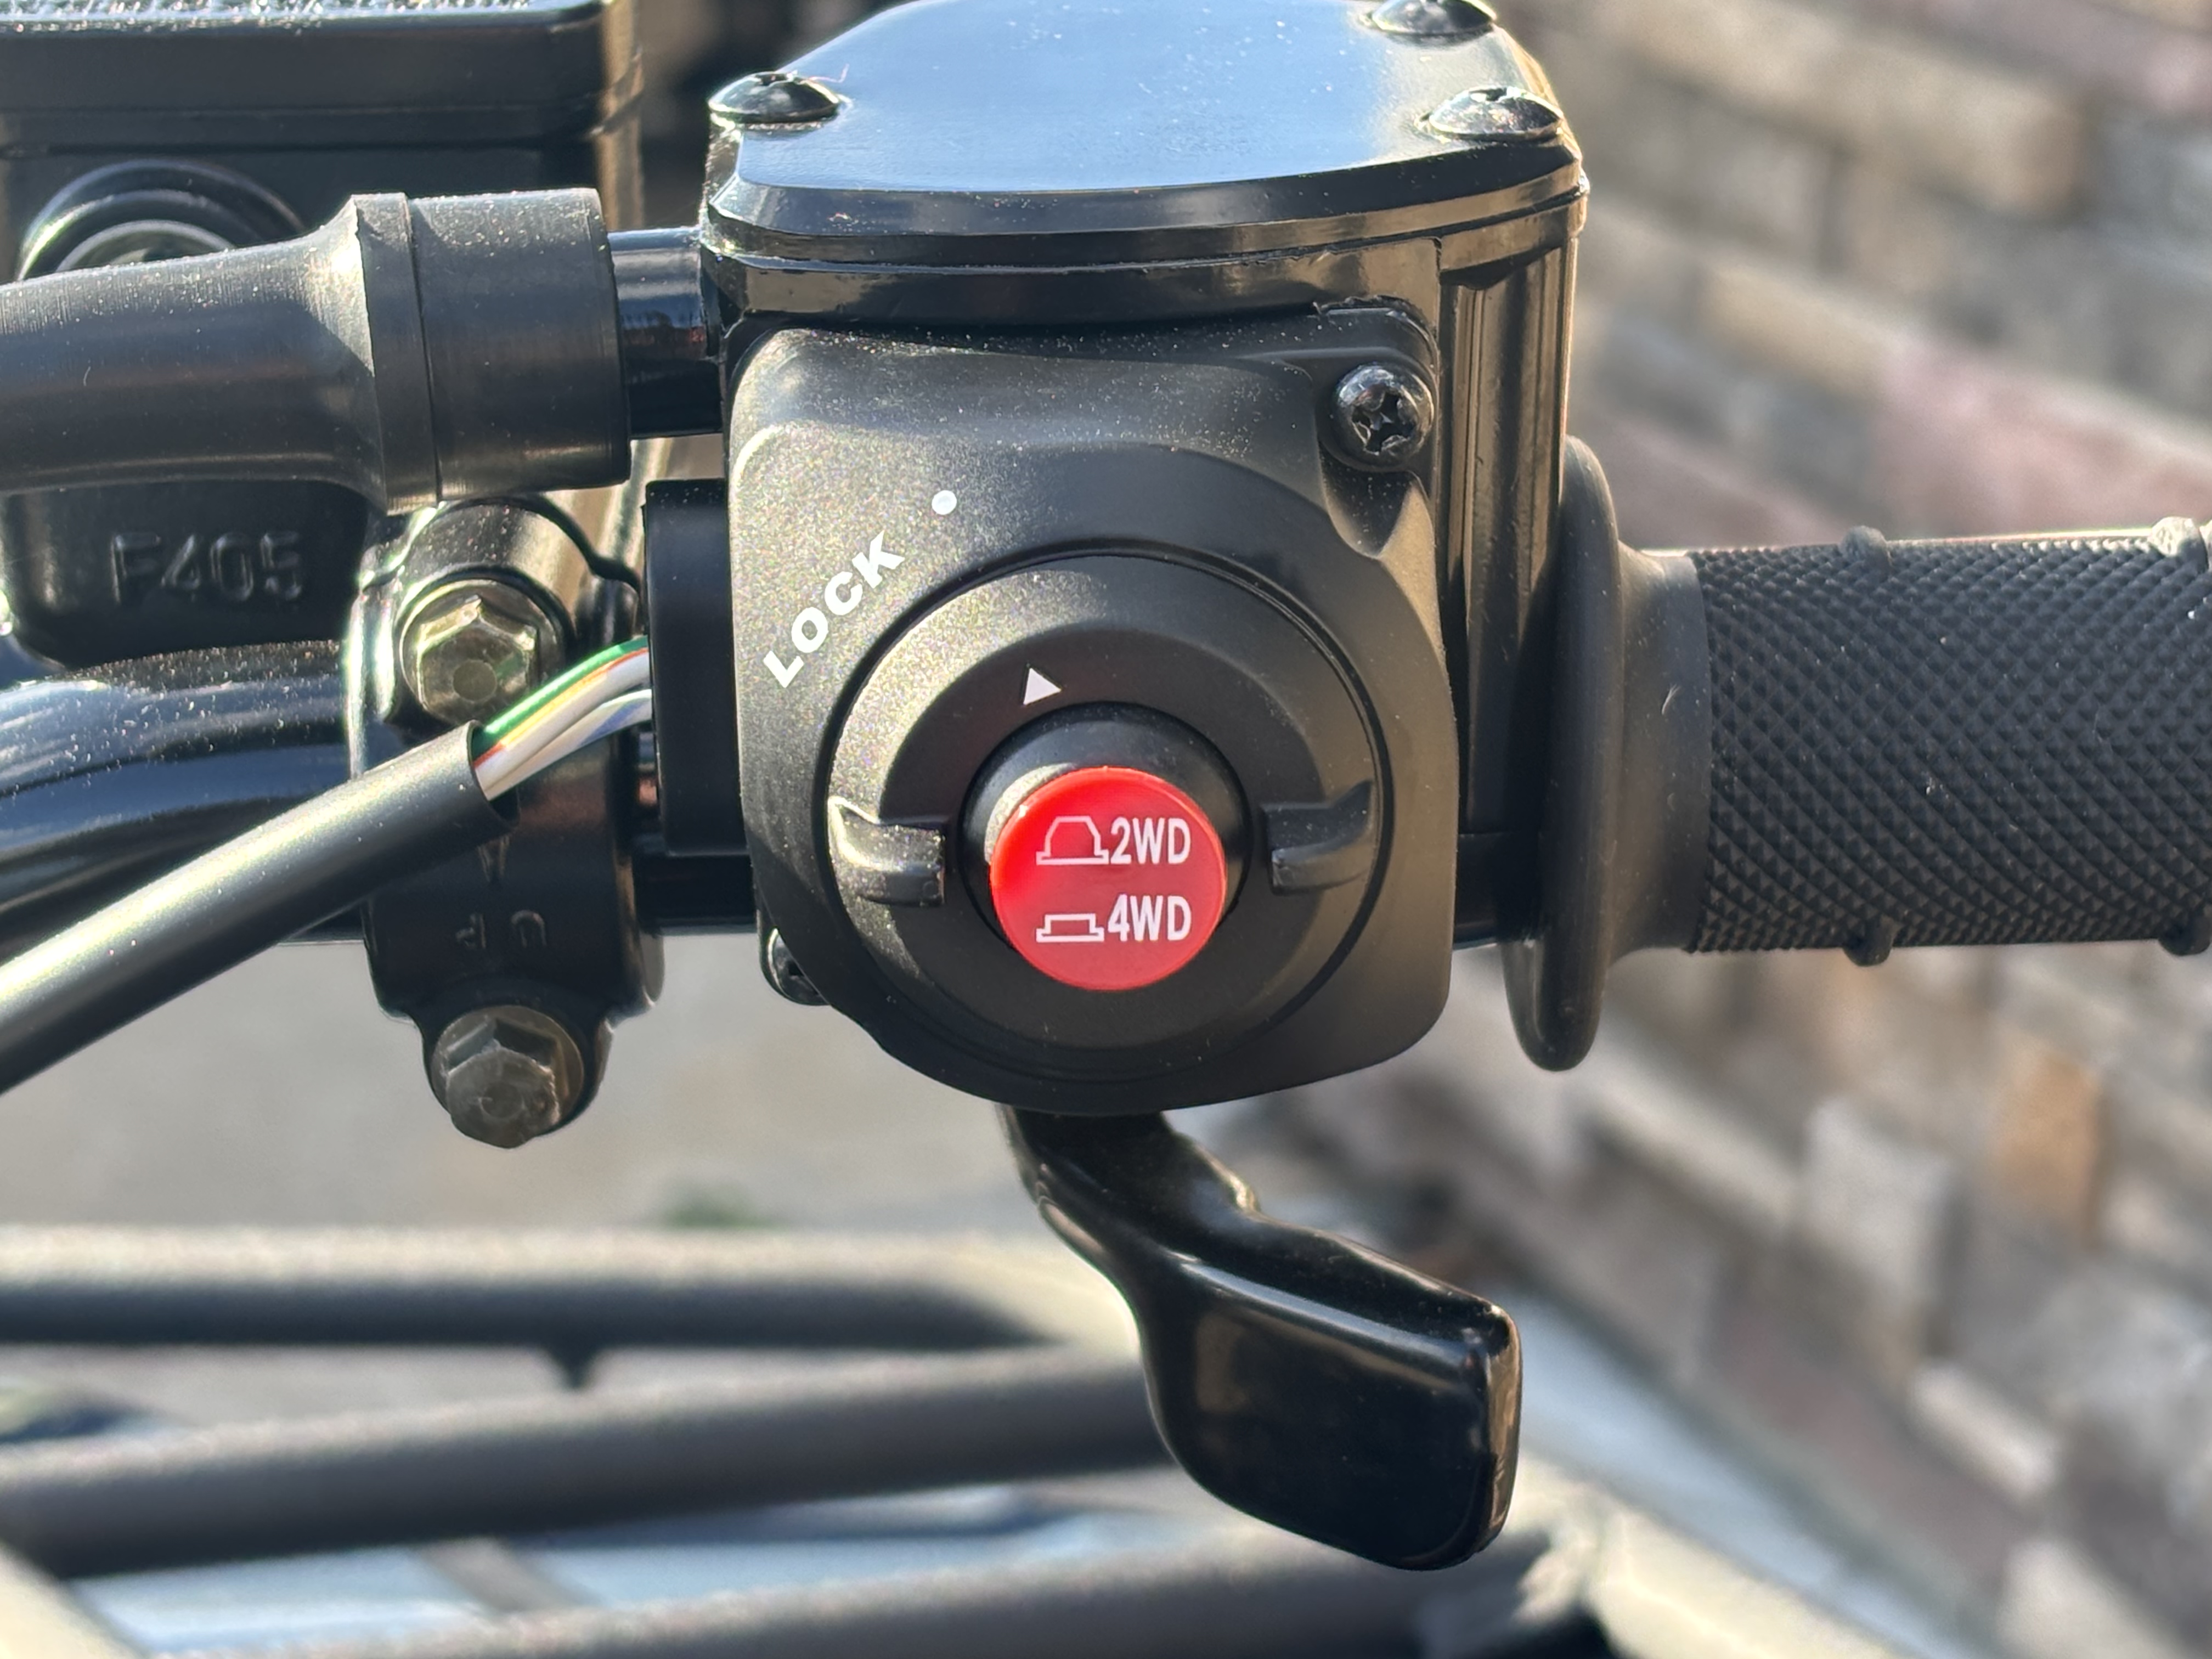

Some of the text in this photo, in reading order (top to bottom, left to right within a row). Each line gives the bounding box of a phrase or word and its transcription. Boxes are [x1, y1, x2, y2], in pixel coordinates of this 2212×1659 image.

[110, 532, 303, 604] F405
[763, 531, 905, 687] LOCK
[1110, 817, 1191, 865] 2WD
[1107, 895, 1192, 942] 4WD
